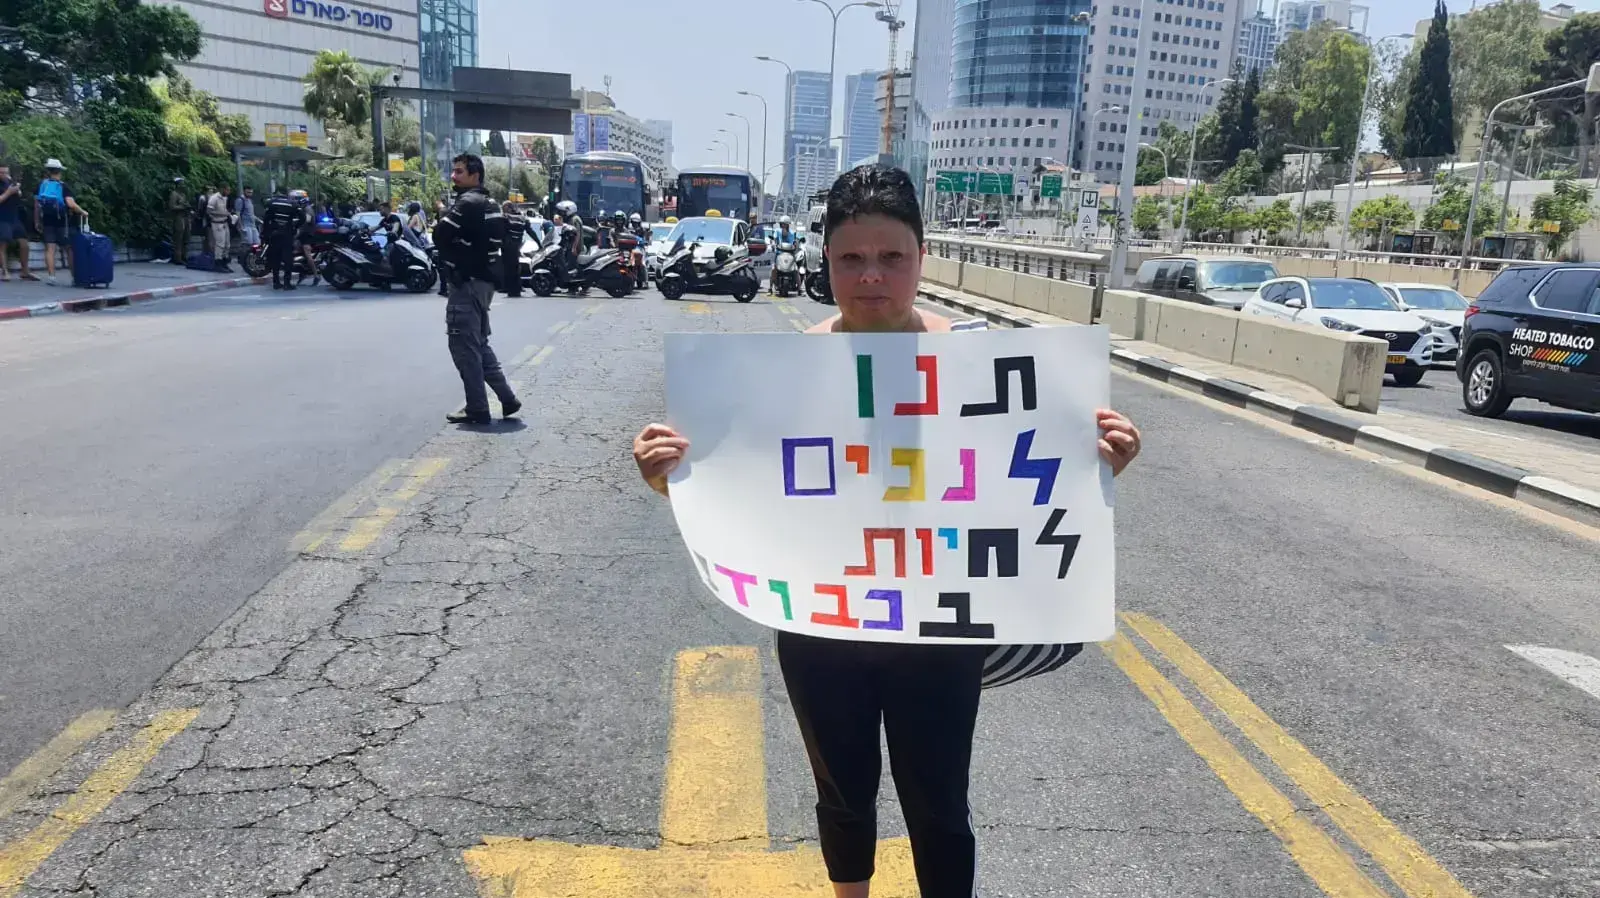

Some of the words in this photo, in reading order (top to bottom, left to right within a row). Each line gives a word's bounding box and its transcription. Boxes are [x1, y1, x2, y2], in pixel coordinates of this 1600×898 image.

[1509, 343, 1534, 357] SHOP
[1512, 327, 1547, 343] HEATED
[1548, 332, 1594, 350] TOBACCO
[856, 353, 1037, 417] תנו
[782, 428, 1061, 505] לנכים
[843, 508, 1081, 579] לחיות
